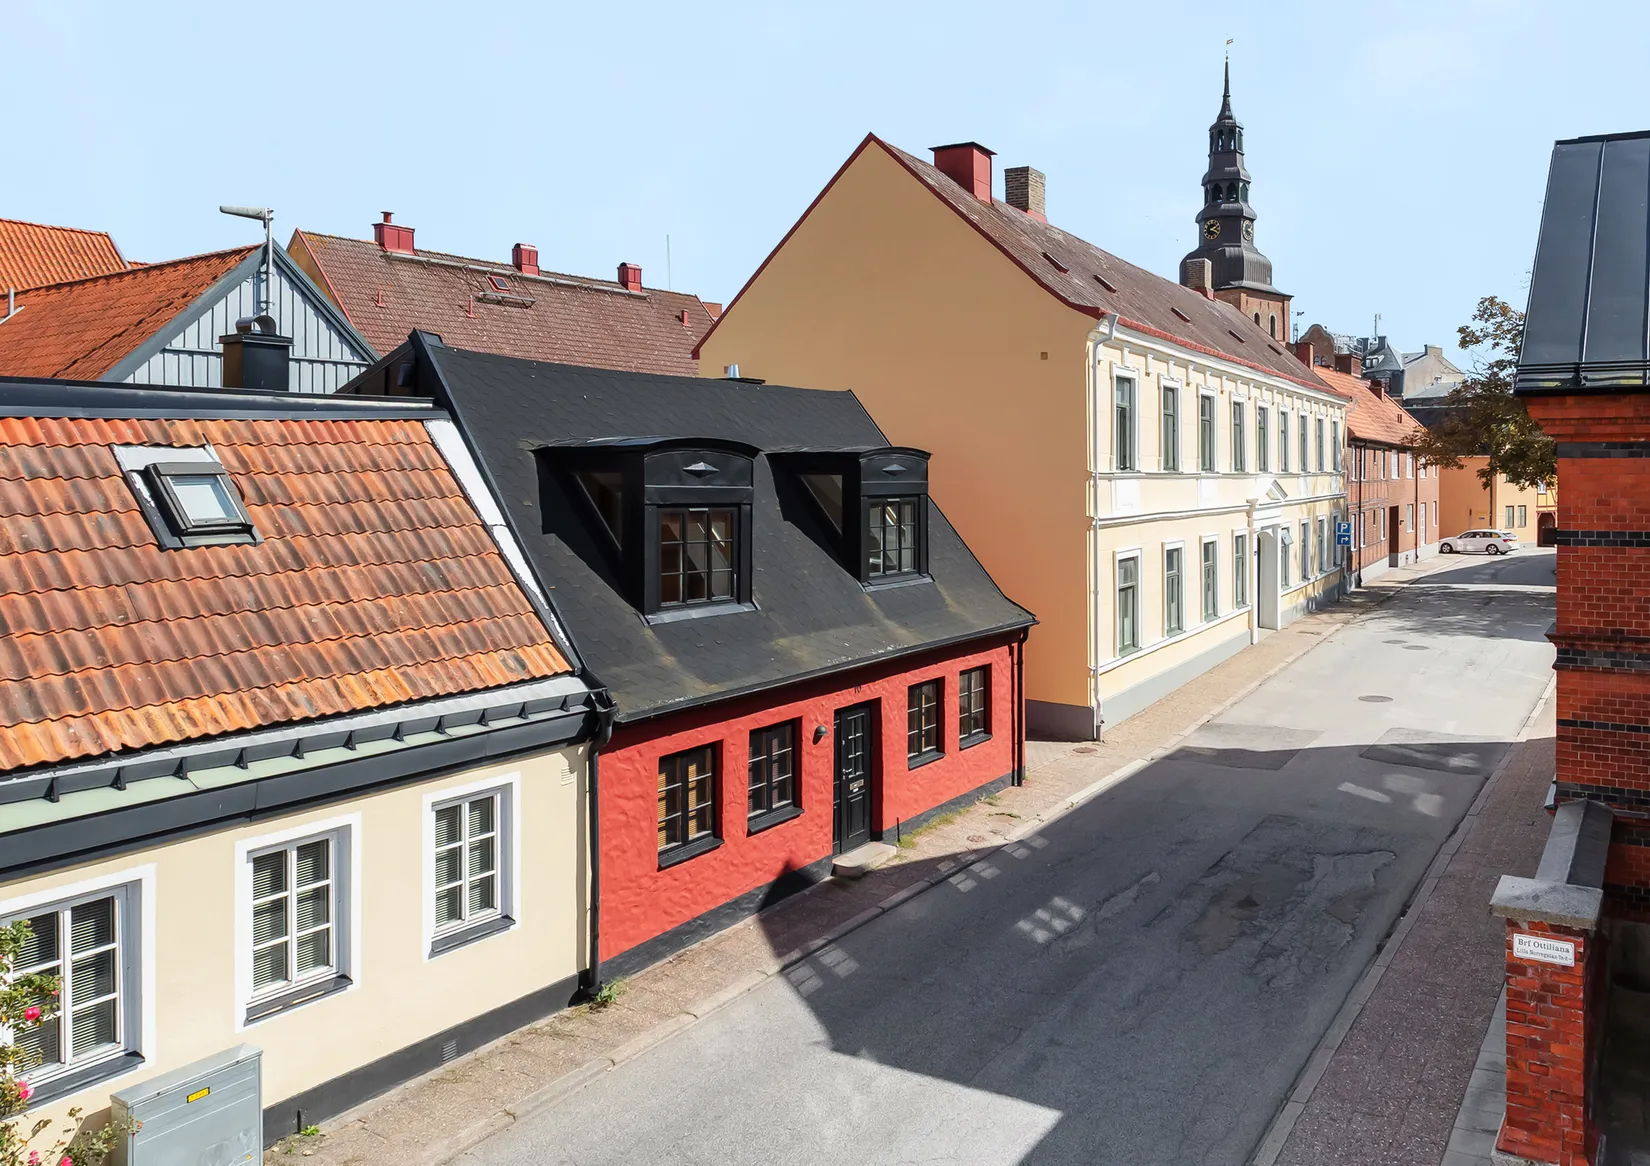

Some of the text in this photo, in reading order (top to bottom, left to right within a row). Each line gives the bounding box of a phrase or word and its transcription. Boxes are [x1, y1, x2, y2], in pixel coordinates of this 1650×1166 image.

[1340, 523, 1348, 533] P
[1518, 938, 1570, 954] Brf Ottiliana
